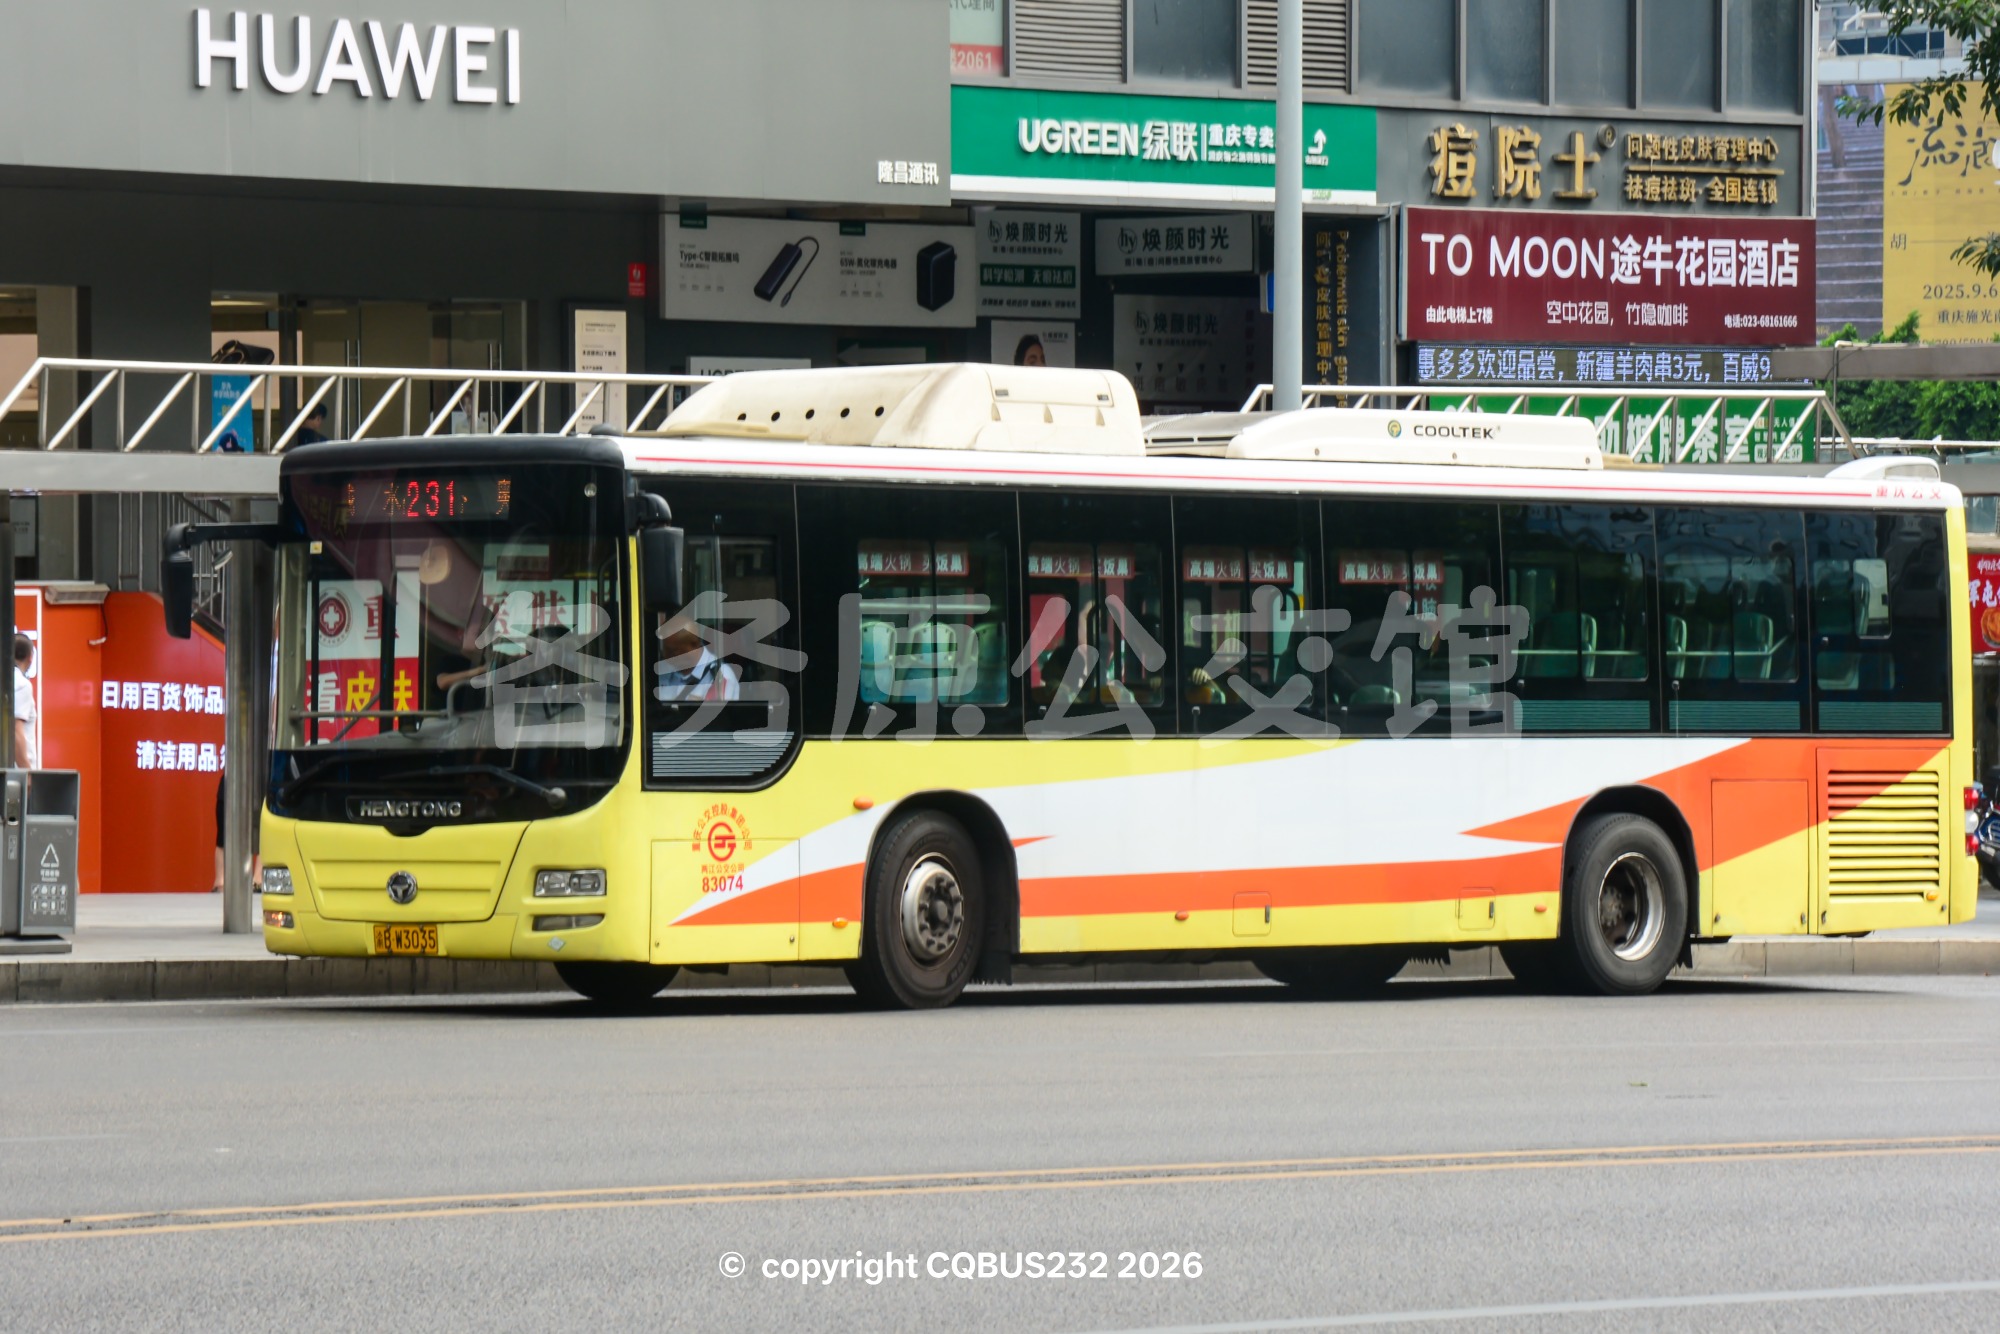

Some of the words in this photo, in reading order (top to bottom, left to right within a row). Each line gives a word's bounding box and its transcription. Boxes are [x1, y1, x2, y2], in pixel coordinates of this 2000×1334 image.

[194, 8, 520, 105] HUAWEI
[1018, 118, 1139, 157] UGREEN
[1142, 120, 1198, 162] 绿联
[1625, 132, 1779, 163] 问题性皮肤管理中心
[1429, 122, 1600, 200] 痘院士
[878, 160, 939, 185] 隆昌通讯
[1005, 221, 1068, 243] 焕颜时光
[1142, 225, 1229, 252] 焕颜时光
[1890, 233, 1908, 251] 胡
[1420, 232, 1473, 277] TO
[1488, 234, 1604, 280] MOON
[1609, 235, 1800, 287] 途牛花园酒店
[1923, 284, 1998, 300] 2025.9.6
[1426, 304, 1493, 325] 由此电梯上7楼
[1413, 425, 1494, 440] COOLTEK
[407, 481, 454, 517] 231
[858, 553, 912, 573] 高端火锅
[1028, 555, 1080, 575] 高端火锅
[1190, 559, 1241, 580] 高端火锅
[1345, 562, 1393, 581] 高端火锅
[102, 680, 225, 714] 日用百货饰品
[360, 800, 462, 817] HENGTONG
[702, 874, 744, 893] 83074
